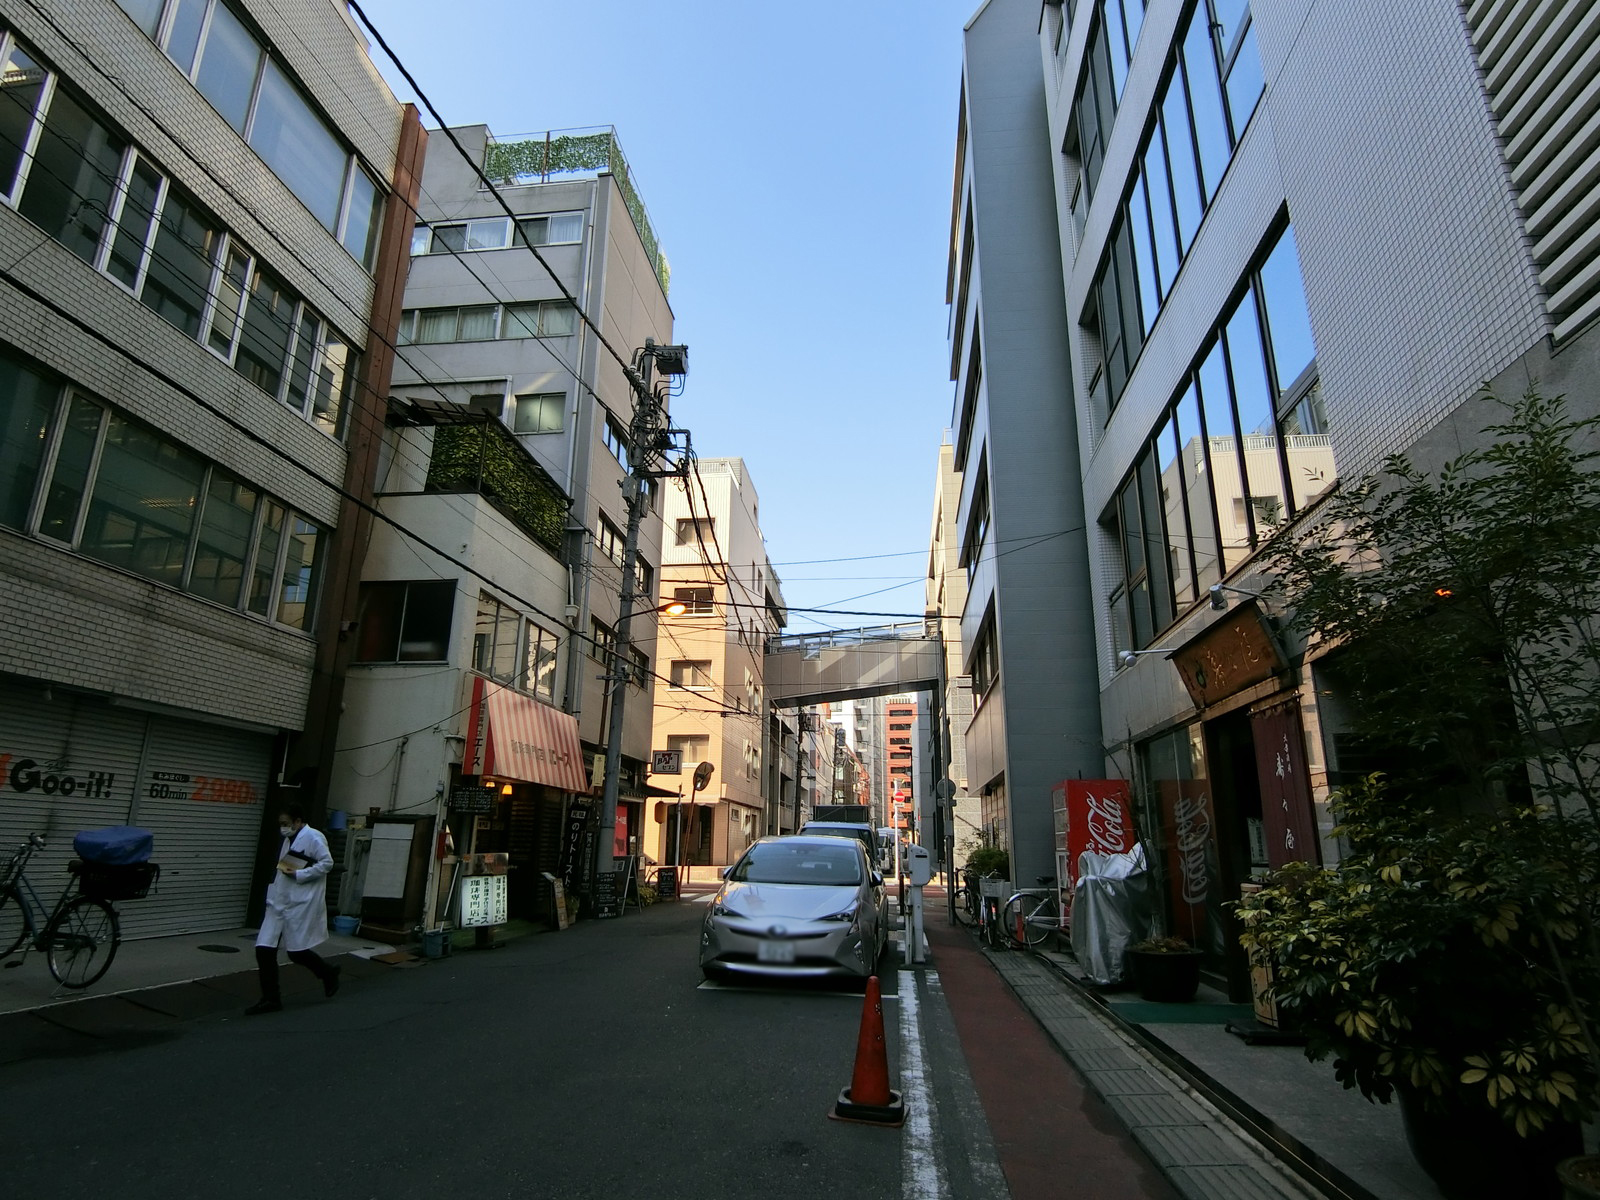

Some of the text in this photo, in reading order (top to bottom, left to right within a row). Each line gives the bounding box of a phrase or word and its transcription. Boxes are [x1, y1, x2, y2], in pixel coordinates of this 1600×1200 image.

[472, 738, 483, 767] エース
[11, 759, 115, 798] Goo-it!
[150, 783, 188, 800] 60min
[565, 823, 580, 886] のりトースト
[465, 917, 489, 926] エース
